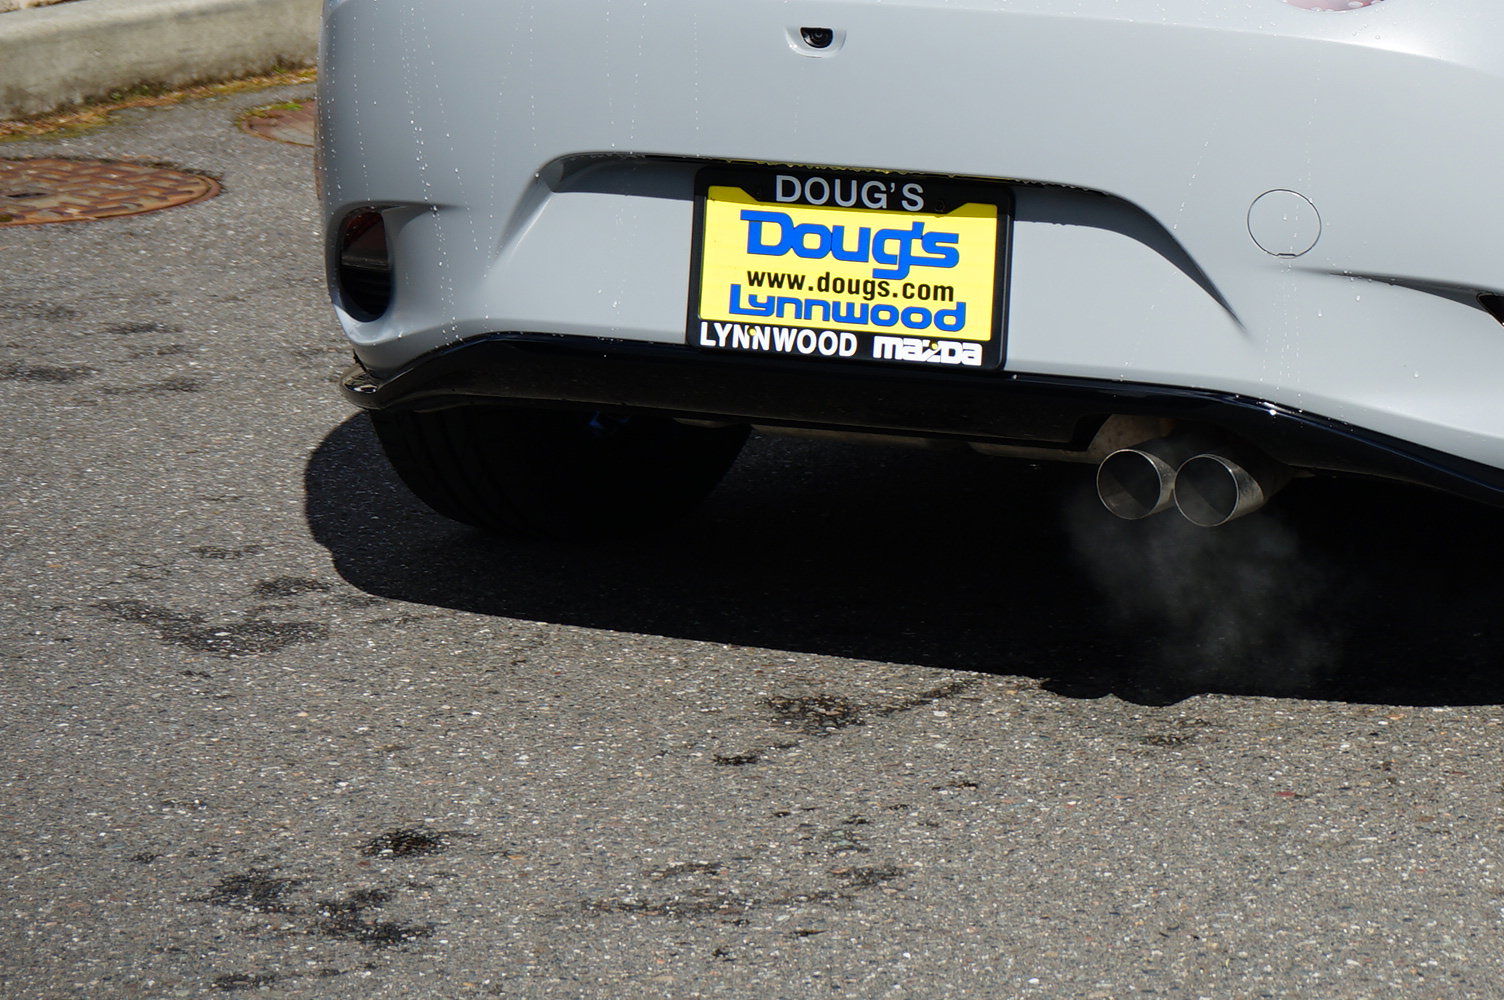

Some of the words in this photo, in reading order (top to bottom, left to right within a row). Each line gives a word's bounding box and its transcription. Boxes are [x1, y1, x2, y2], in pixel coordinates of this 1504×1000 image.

[775, 174, 924, 212] DOUG'S
[740, 209, 960, 280] Doug's
[746, 270, 954, 302] www.dougs.com
[729, 283, 967, 332] Lynnwood
[700, 321, 858, 357] LYNNWOOD
